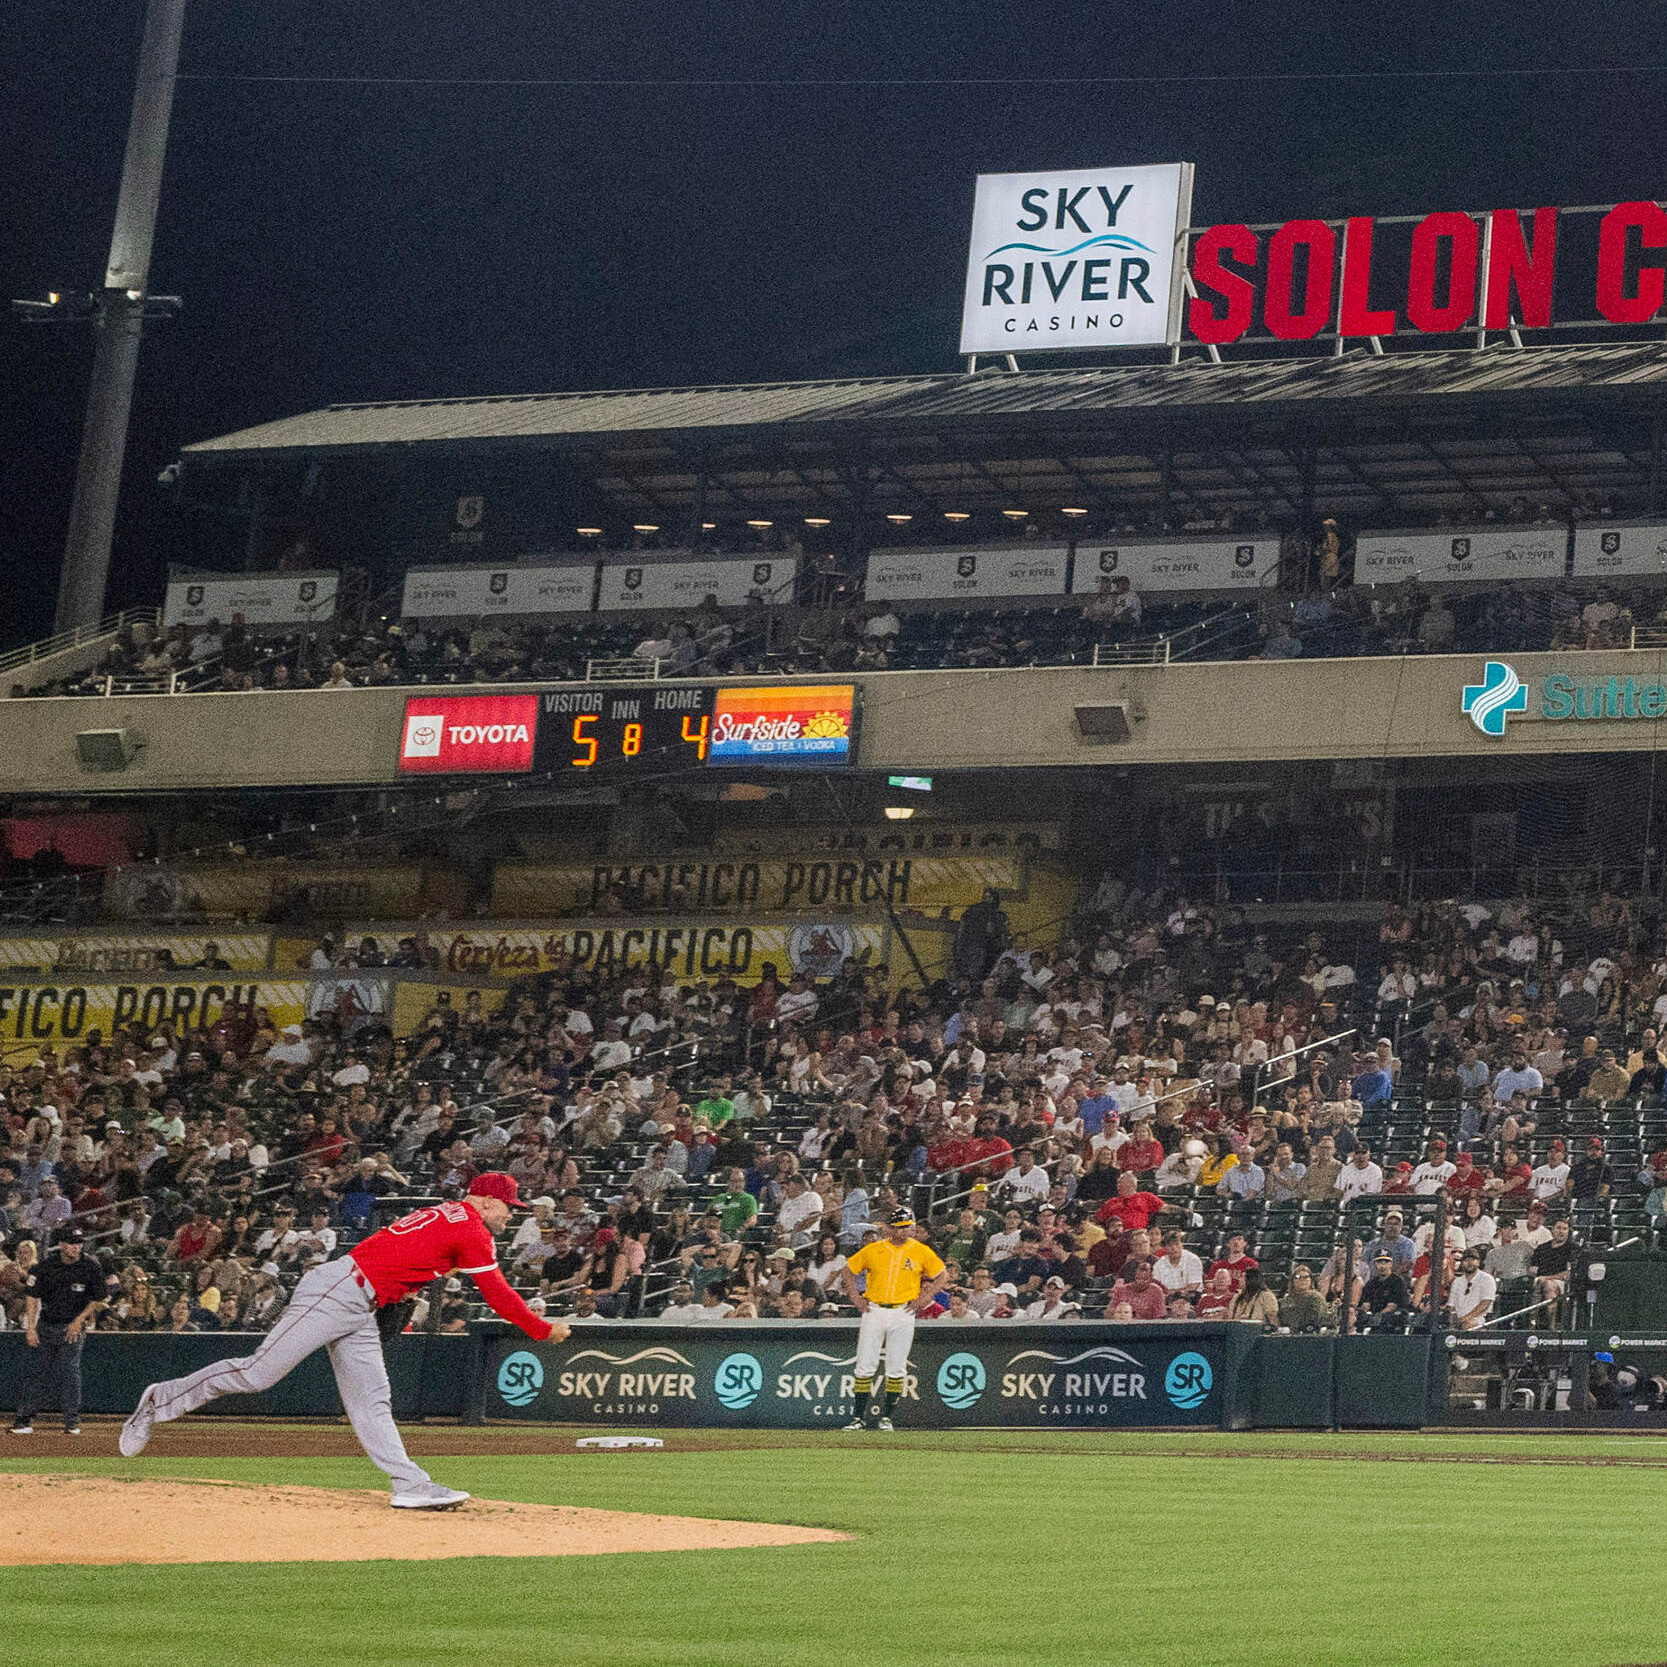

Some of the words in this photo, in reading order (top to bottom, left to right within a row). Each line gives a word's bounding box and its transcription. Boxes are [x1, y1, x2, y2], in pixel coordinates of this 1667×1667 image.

[1016, 184, 1134, 234] SKY
[981, 256, 1155, 307] RIVER
[1188, 203, 1560, 345] SOLON
[1004, 313, 1124, 333] CASINO
[544, 693, 604, 713] VISITOR
[611, 700, 640, 719] INN
[653, 690, 702, 710] HOME
[448, 723, 529, 745] TOYOTA
[571, 715, 600, 766] 5
[622, 723, 643, 756] 8
[681, 715, 710, 761] 4
[712, 713, 801, 745] Surfside
[752, 741, 774, 752] ICED
[783, 860, 912, 905] PORCH
[572, 927, 754, 977] PACIFICO
[505, 1362, 536, 1388] SR
[557, 1372, 612, 1399] SKY
[618, 1372, 697, 1400] RIVER
[722, 1364, 755, 1390] SR
[775, 1374, 832, 1401] SKY
[840, 1374, 921, 1401] RVR
[943, 1364, 978, 1390] SR
[1000, 1373, 1056, 1400] SKY
[1065, 1373, 1148, 1400] RIVER
[1172, 1363, 1206, 1390] SR
[593, 1403, 660, 1414] CASINO
[812, 1404, 881, 1416] CASIO
[1038, 1404, 1109, 1415] CASINO
